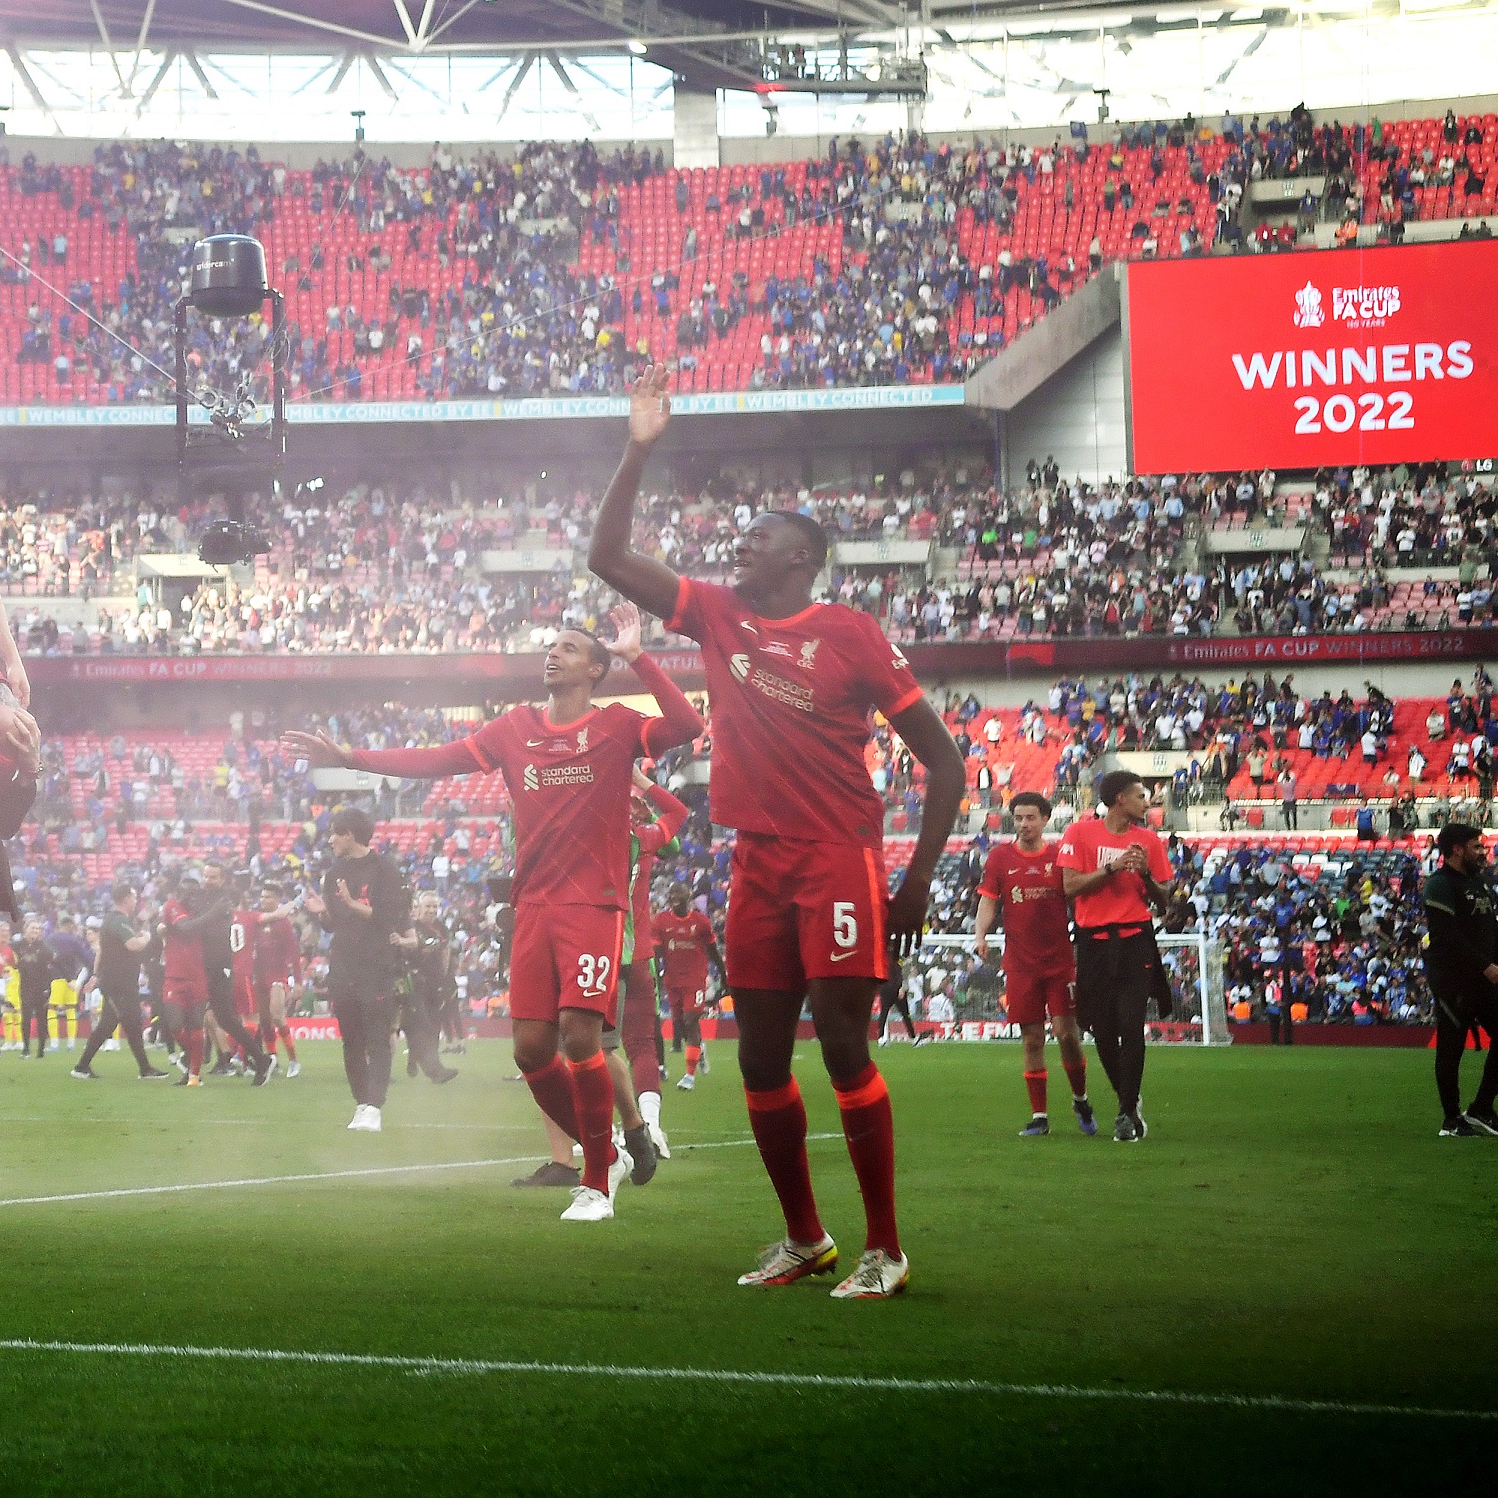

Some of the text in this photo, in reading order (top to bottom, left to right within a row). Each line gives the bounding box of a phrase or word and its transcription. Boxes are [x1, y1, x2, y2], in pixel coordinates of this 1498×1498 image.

[1333, 285, 1399, 302] Emirates
[1333, 299, 1401, 320] FA CUP
[1232, 340, 1474, 390] WINNERS
[503, 400, 582, 416] WEMBLEY
[689, 397, 711, 411] BY
[748, 389, 932, 409] WEMBLEY CONNECTED
[28, 409, 104, 422] WEMBLEY
[346, 404, 442, 419] CONNECTED
[448, 403, 468, 417] BY
[1294, 391, 1415, 434] 2022
[1476, 458, 1493, 472] LG
[1184, 637, 1463, 660] Emirates FA CUP WINNERS 2022
[150, 660, 168, 675] FA
[174, 660, 206, 675] CUP
[754, 668, 814, 700] standard
[751, 678, 815, 713] chartered
[541, 765, 590, 778] standard
[543, 774, 594, 786] chartered
[833, 901, 858, 948] 5
[576, 954, 610, 992] 32
